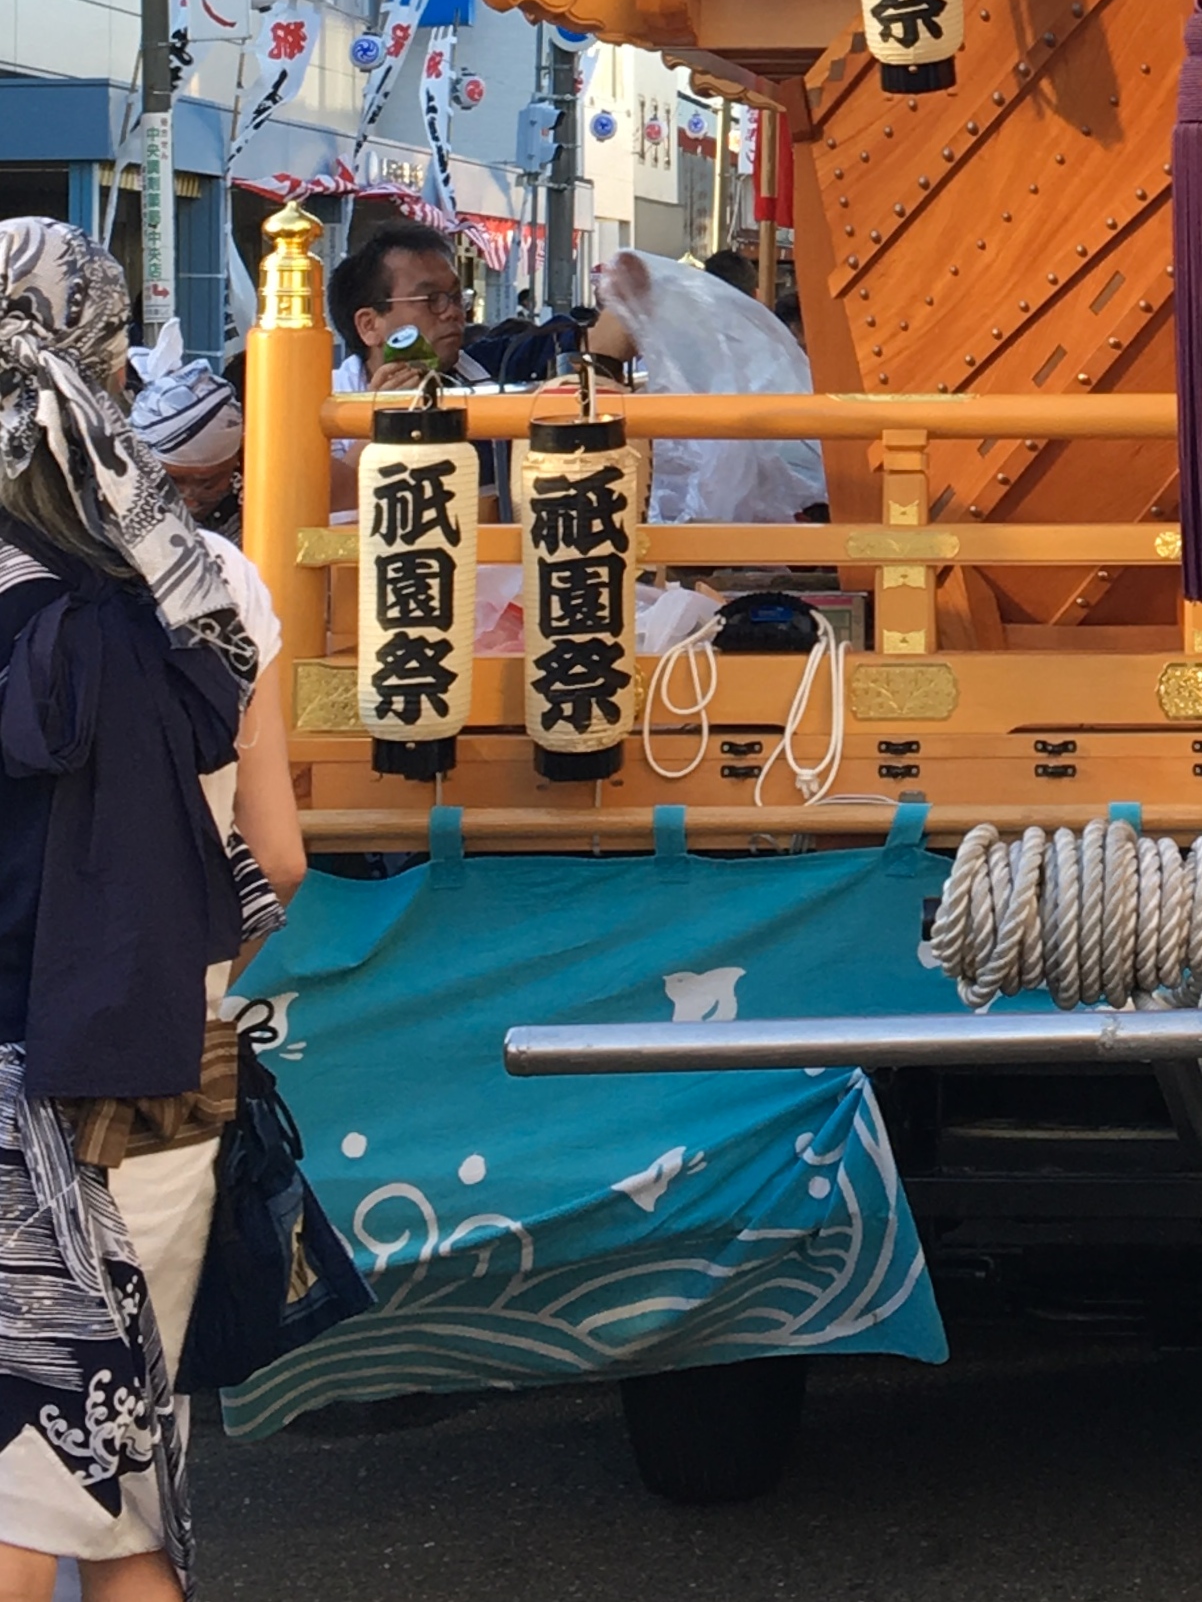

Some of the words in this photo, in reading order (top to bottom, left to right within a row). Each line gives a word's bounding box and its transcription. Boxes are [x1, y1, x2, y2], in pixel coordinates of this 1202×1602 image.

[370, 459, 461, 725] 祇園祭
[530, 465, 631, 734] 祇園祭
